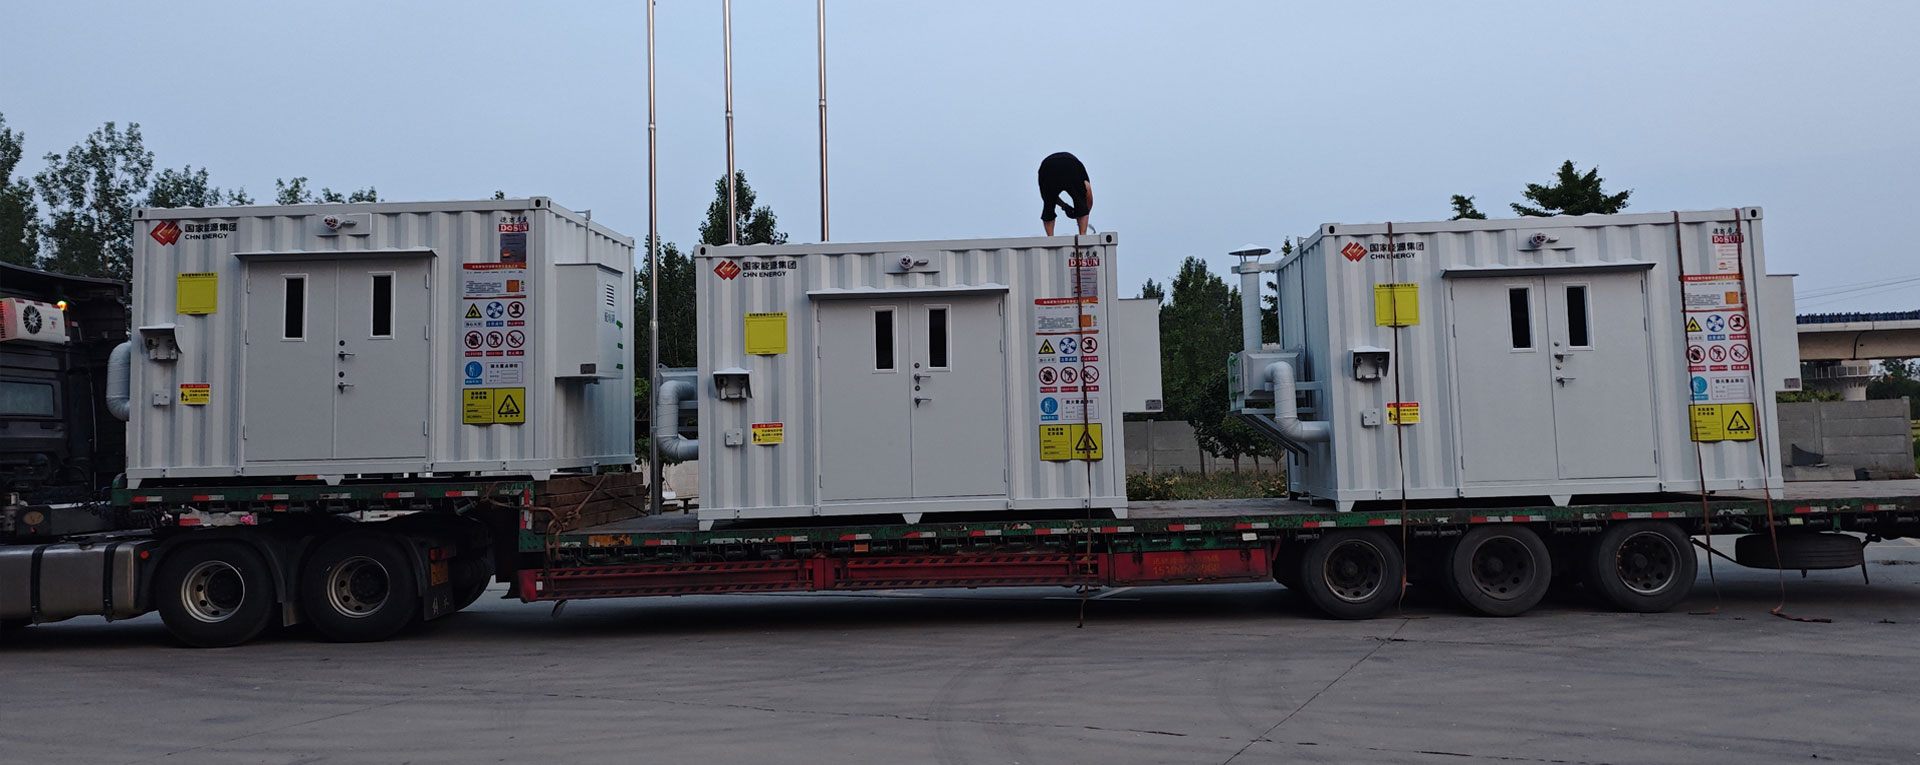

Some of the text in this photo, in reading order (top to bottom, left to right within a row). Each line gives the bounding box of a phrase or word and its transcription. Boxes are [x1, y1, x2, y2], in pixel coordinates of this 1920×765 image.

[184, 222, 237, 233] 国家能源集团
[1369, 241, 1424, 253] 国家能源集团
[742, 260, 797, 271] 国家能源集团
[759, 270, 787, 278] ENERGY
